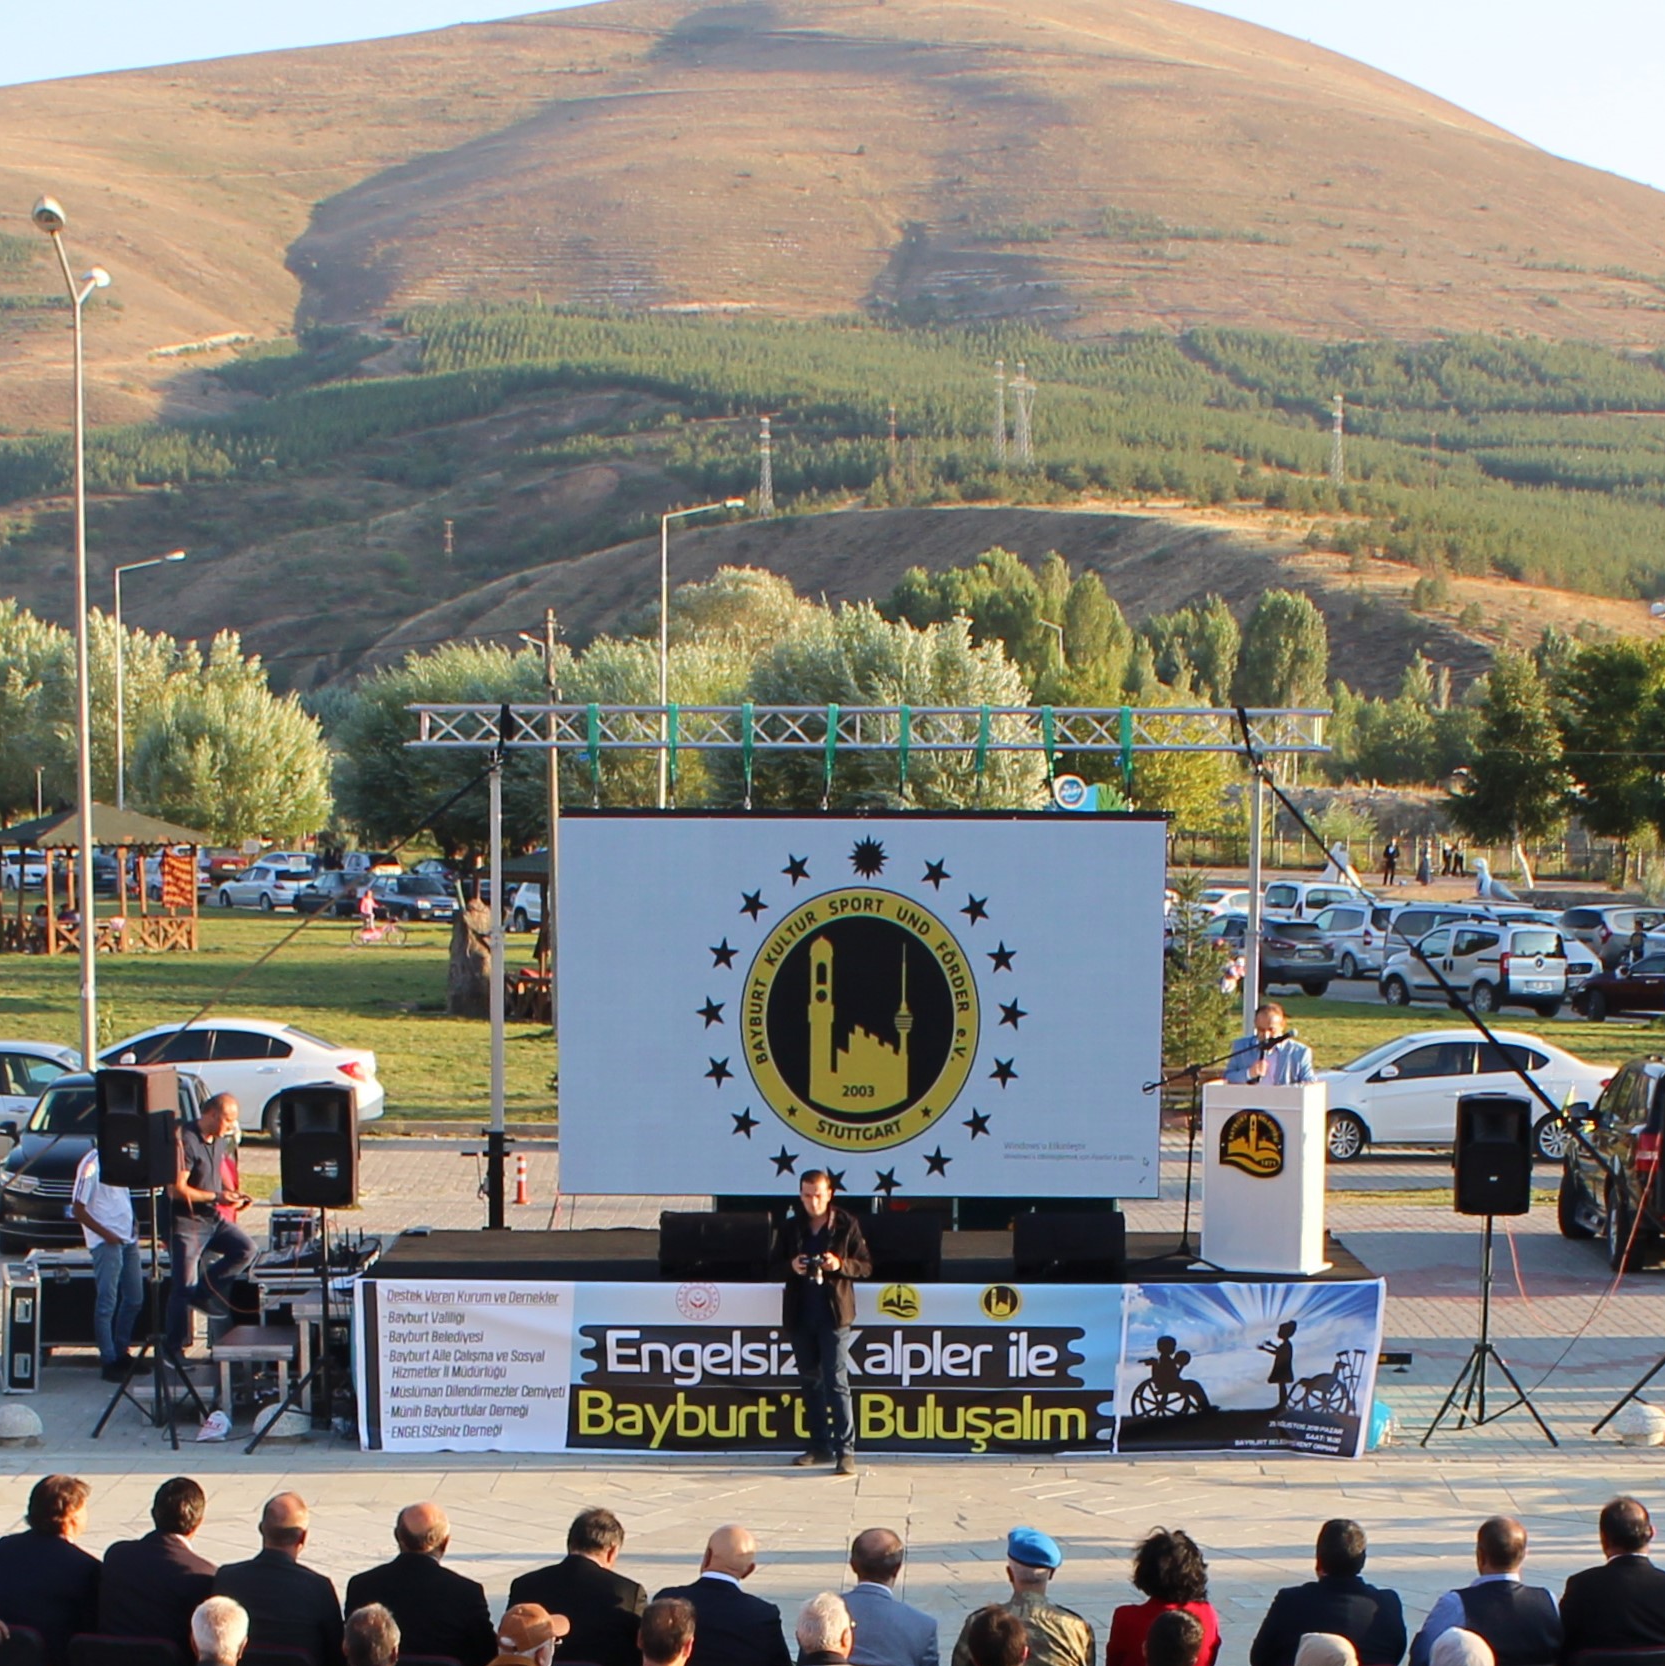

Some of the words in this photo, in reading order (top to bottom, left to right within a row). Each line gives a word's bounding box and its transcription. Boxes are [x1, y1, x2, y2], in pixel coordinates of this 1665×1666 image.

[828, 897, 884, 916] SPORT
[896, 905, 931, 936] UND
[764, 910, 818, 967] KULTUR
[934, 940, 970, 1013] FÖRDER
[749, 977, 768, 1066] BAYBURT
[951, 1027, 968, 1062] e.V.
[841, 1084, 876, 1098] 2003
[815, 1119, 903, 1141] STUTTGART
[387, 1289, 422, 1303] Destek
[425, 1290, 455, 1303] Veren
[457, 1290, 492, 1303] Kurum
[493, 1293, 507, 1304] ve
[508, 1291, 560, 1304] Dernekler
[431, 1311, 465, 1326] Valiliği
[431, 1331, 484, 1345] Belediyesi
[432, 1350, 452, 1363] Aile
[453, 1350, 494, 1365] Çalışma
[495, 1352, 509, 1363] ve
[510, 1350, 545, 1365] Sosyal
[605, 1329, 800, 1387] Engelsiz
[1008, 1331, 1058, 1378] ile
[392, 1366, 442, 1379] Hizmetler
[451, 1366, 507, 1381] Müdürlüğü
[445, 1384, 519, 1398] Dilendirmezler
[520, 1384, 566, 1401] Cemiyeti
[423, 1404, 488, 1420] Bayburtlular
[489, 1404, 529, 1420] Derneği
[462, 1424, 504, 1439] Derneği
[859, 1393, 1087, 1453] Buluşalım
